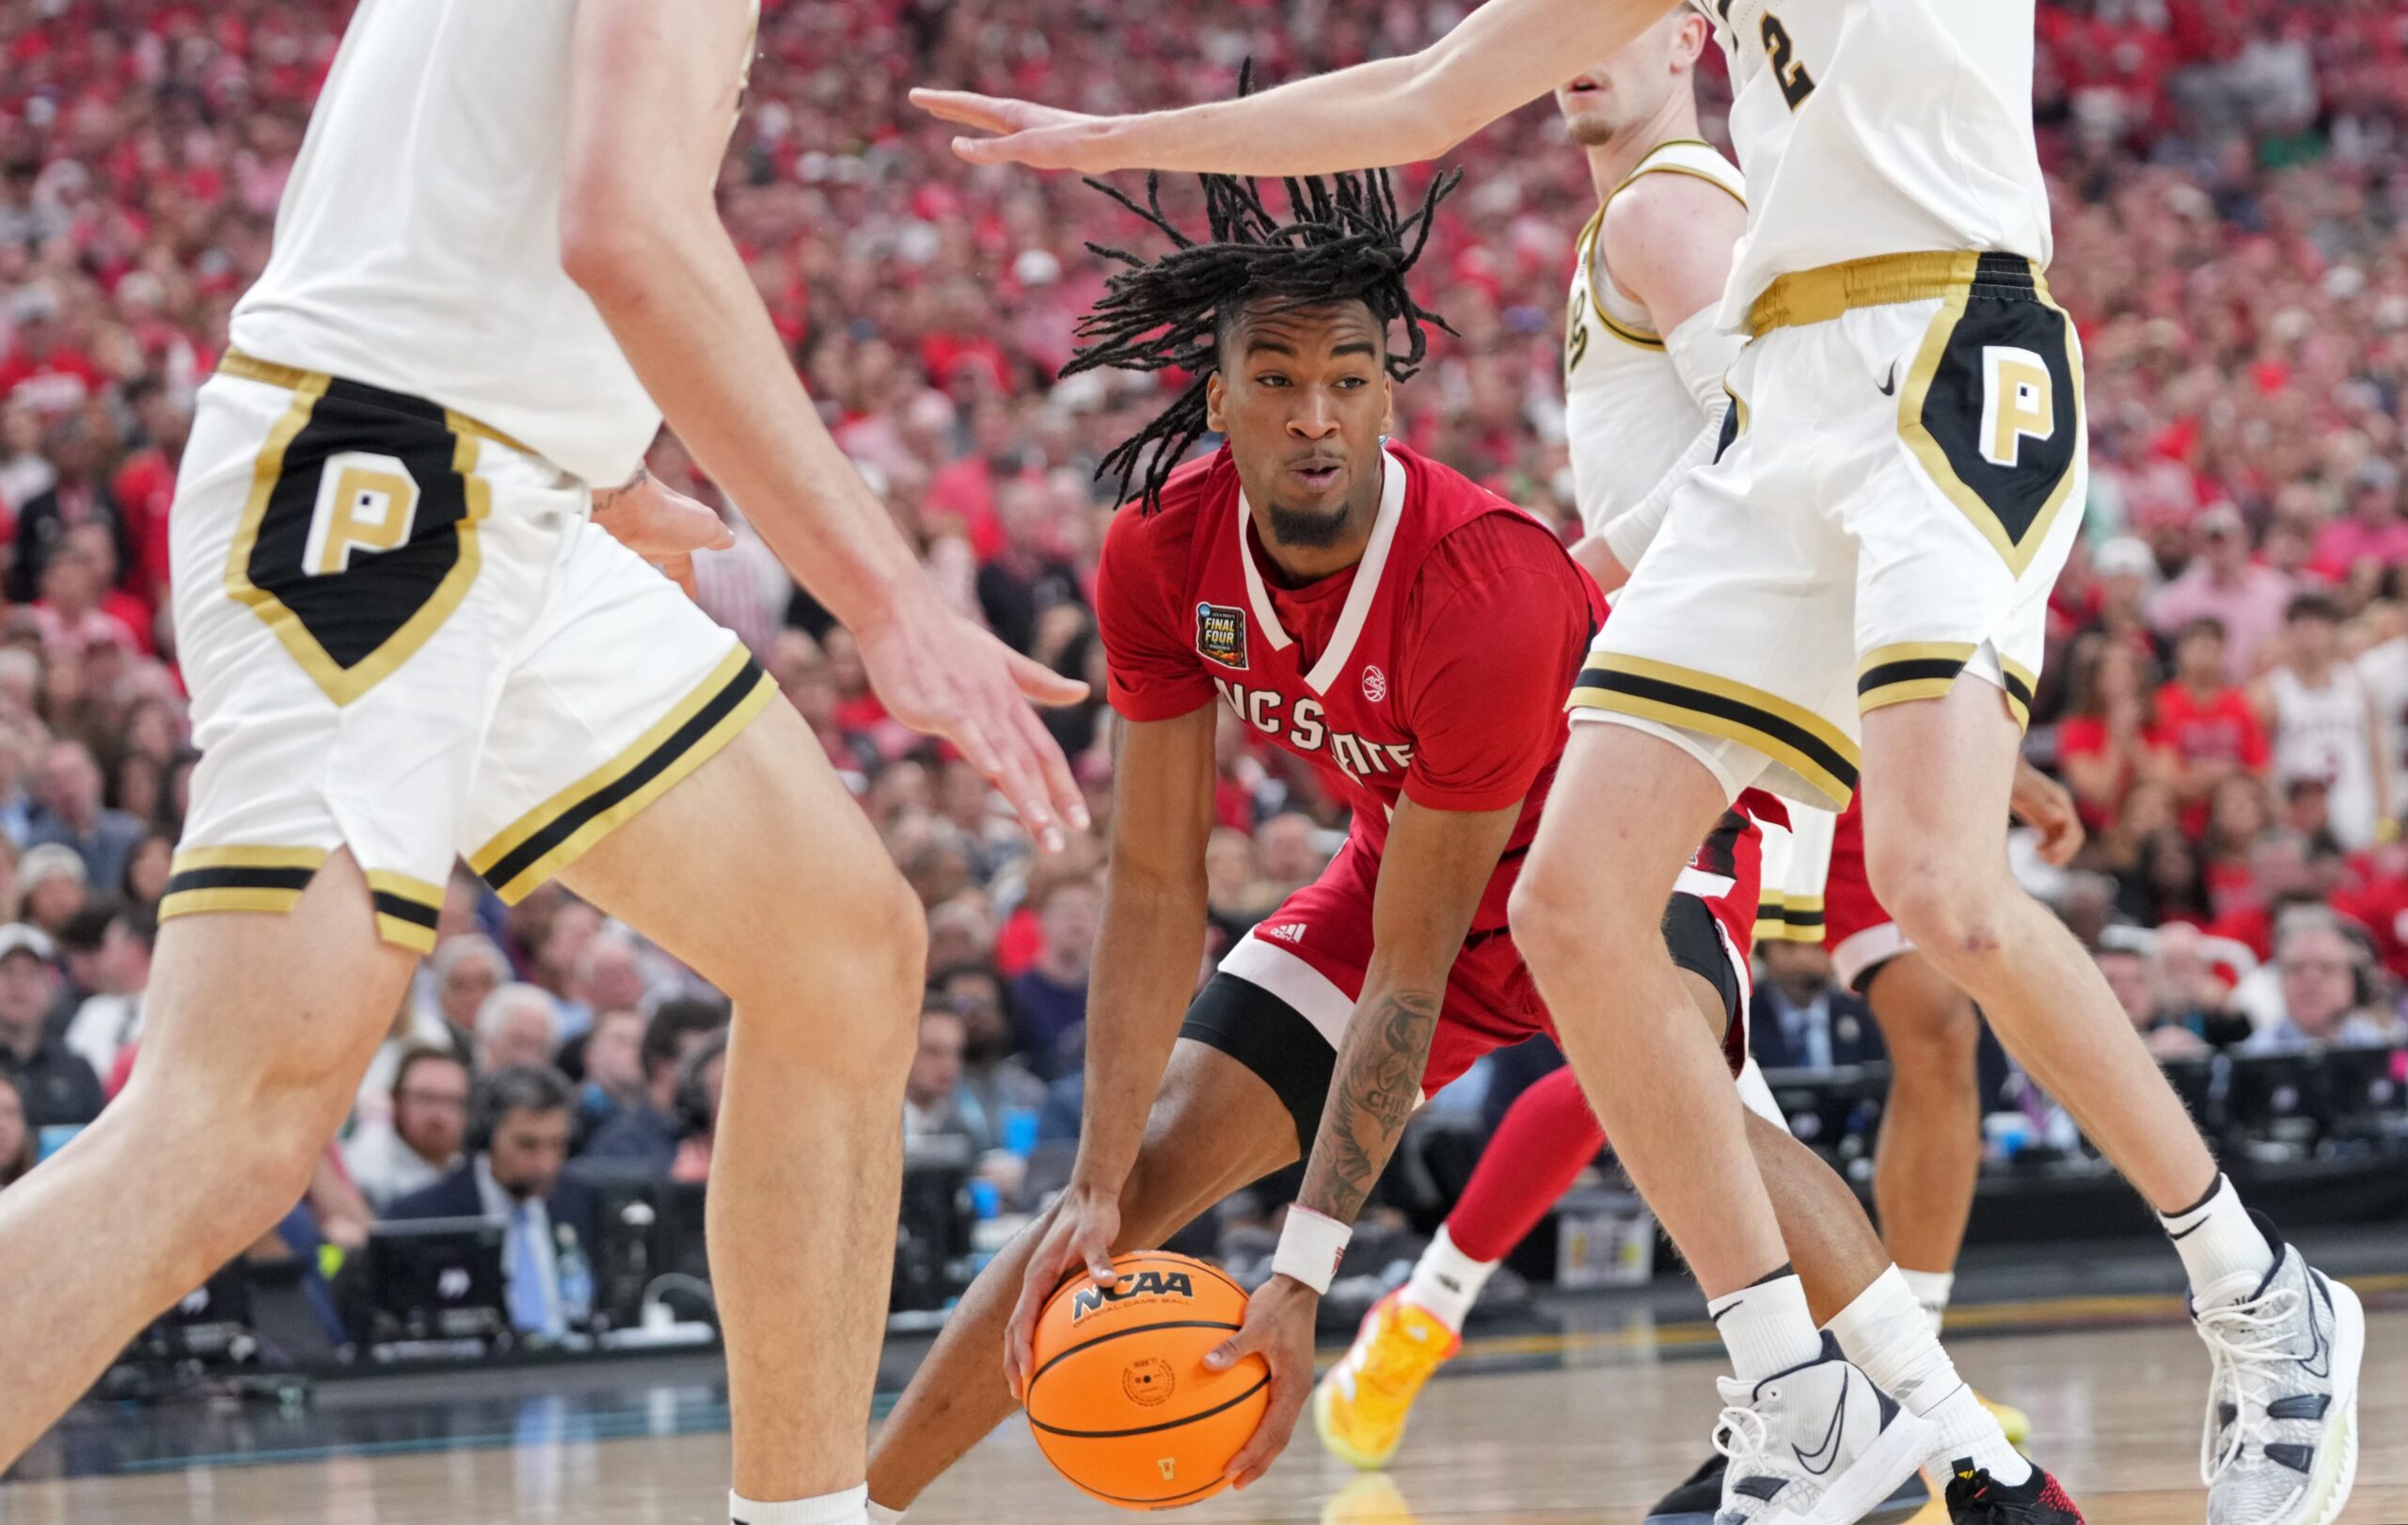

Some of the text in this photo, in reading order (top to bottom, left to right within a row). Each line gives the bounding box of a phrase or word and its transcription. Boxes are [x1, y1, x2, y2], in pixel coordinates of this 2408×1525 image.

[1759, 9, 1816, 114] 2
[1978, 345, 2054, 467] P
[301, 451, 420, 577] P
[1205, 617, 1235, 632] FINAL
[1205, 629, 1234, 644] FOUR
[1213, 675, 1282, 734] NC
[1364, 675, 1385, 691] ACC
[1071, 1271, 1193, 1321] NCAA
[1123, 1297, 1158, 1309] GAME
[1161, 1297, 1193, 1306] BALL
